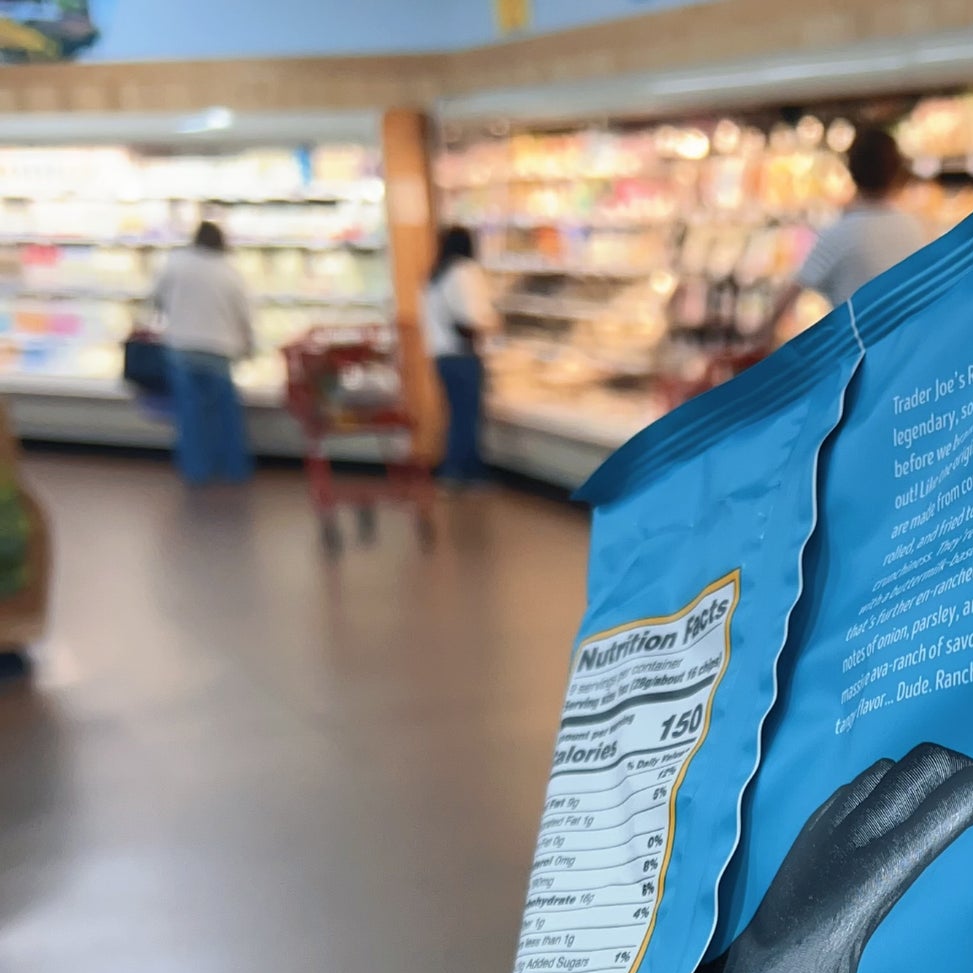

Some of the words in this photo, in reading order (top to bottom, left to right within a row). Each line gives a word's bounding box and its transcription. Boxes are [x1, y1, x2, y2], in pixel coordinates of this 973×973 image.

[893, 387, 931, 415] Trader
[934, 371, 966, 402] Joe's
[893, 410, 959, 449] legendary,
[960, 401, 973, 420] so
[894, 452, 934, 478] before
[936, 442, 952, 461] we
[895, 482, 918, 510] out!
[891, 521, 909, 539] are
[910, 502, 936, 530] made
[937, 485, 960, 512] from
[882, 537, 915, 567] rolled,
[916, 526, 939, 550] and
[938, 507, 965, 537] fried
[846, 614, 876, 641] that's
[876, 597, 917, 626] further
[577, 630, 678, 672] Nutrition
[682, 597, 730, 645] Facts
[842, 647, 866, 673] notes
[866, 635, 879, 657] of
[877, 624, 910, 651] onion,
[911, 604, 960, 640] parsley,
[631, 658, 684, 676] container
[841, 672, 871, 705] massive
[870, 643, 927, 682] ava-ranch
[928, 636, 945, 660] of
[896, 675, 932, 702] Dude.
[591, 726, 609, 742] per
[660, 703, 703, 741] 150
[636, 757, 660, 770] Daily
[657, 766, 677, 780] 12%
[653, 785, 667, 801] 5%
[647, 833, 663, 849] 0%
[643, 858, 658, 873] 8%
[633, 906, 650, 919] 4%
[542, 936, 562, 946] than
[564, 934, 576, 948] 1g
[526, 958, 556, 970] Added
[556, 956, 590, 971] Sugars
[614, 951, 631, 963] 1%
